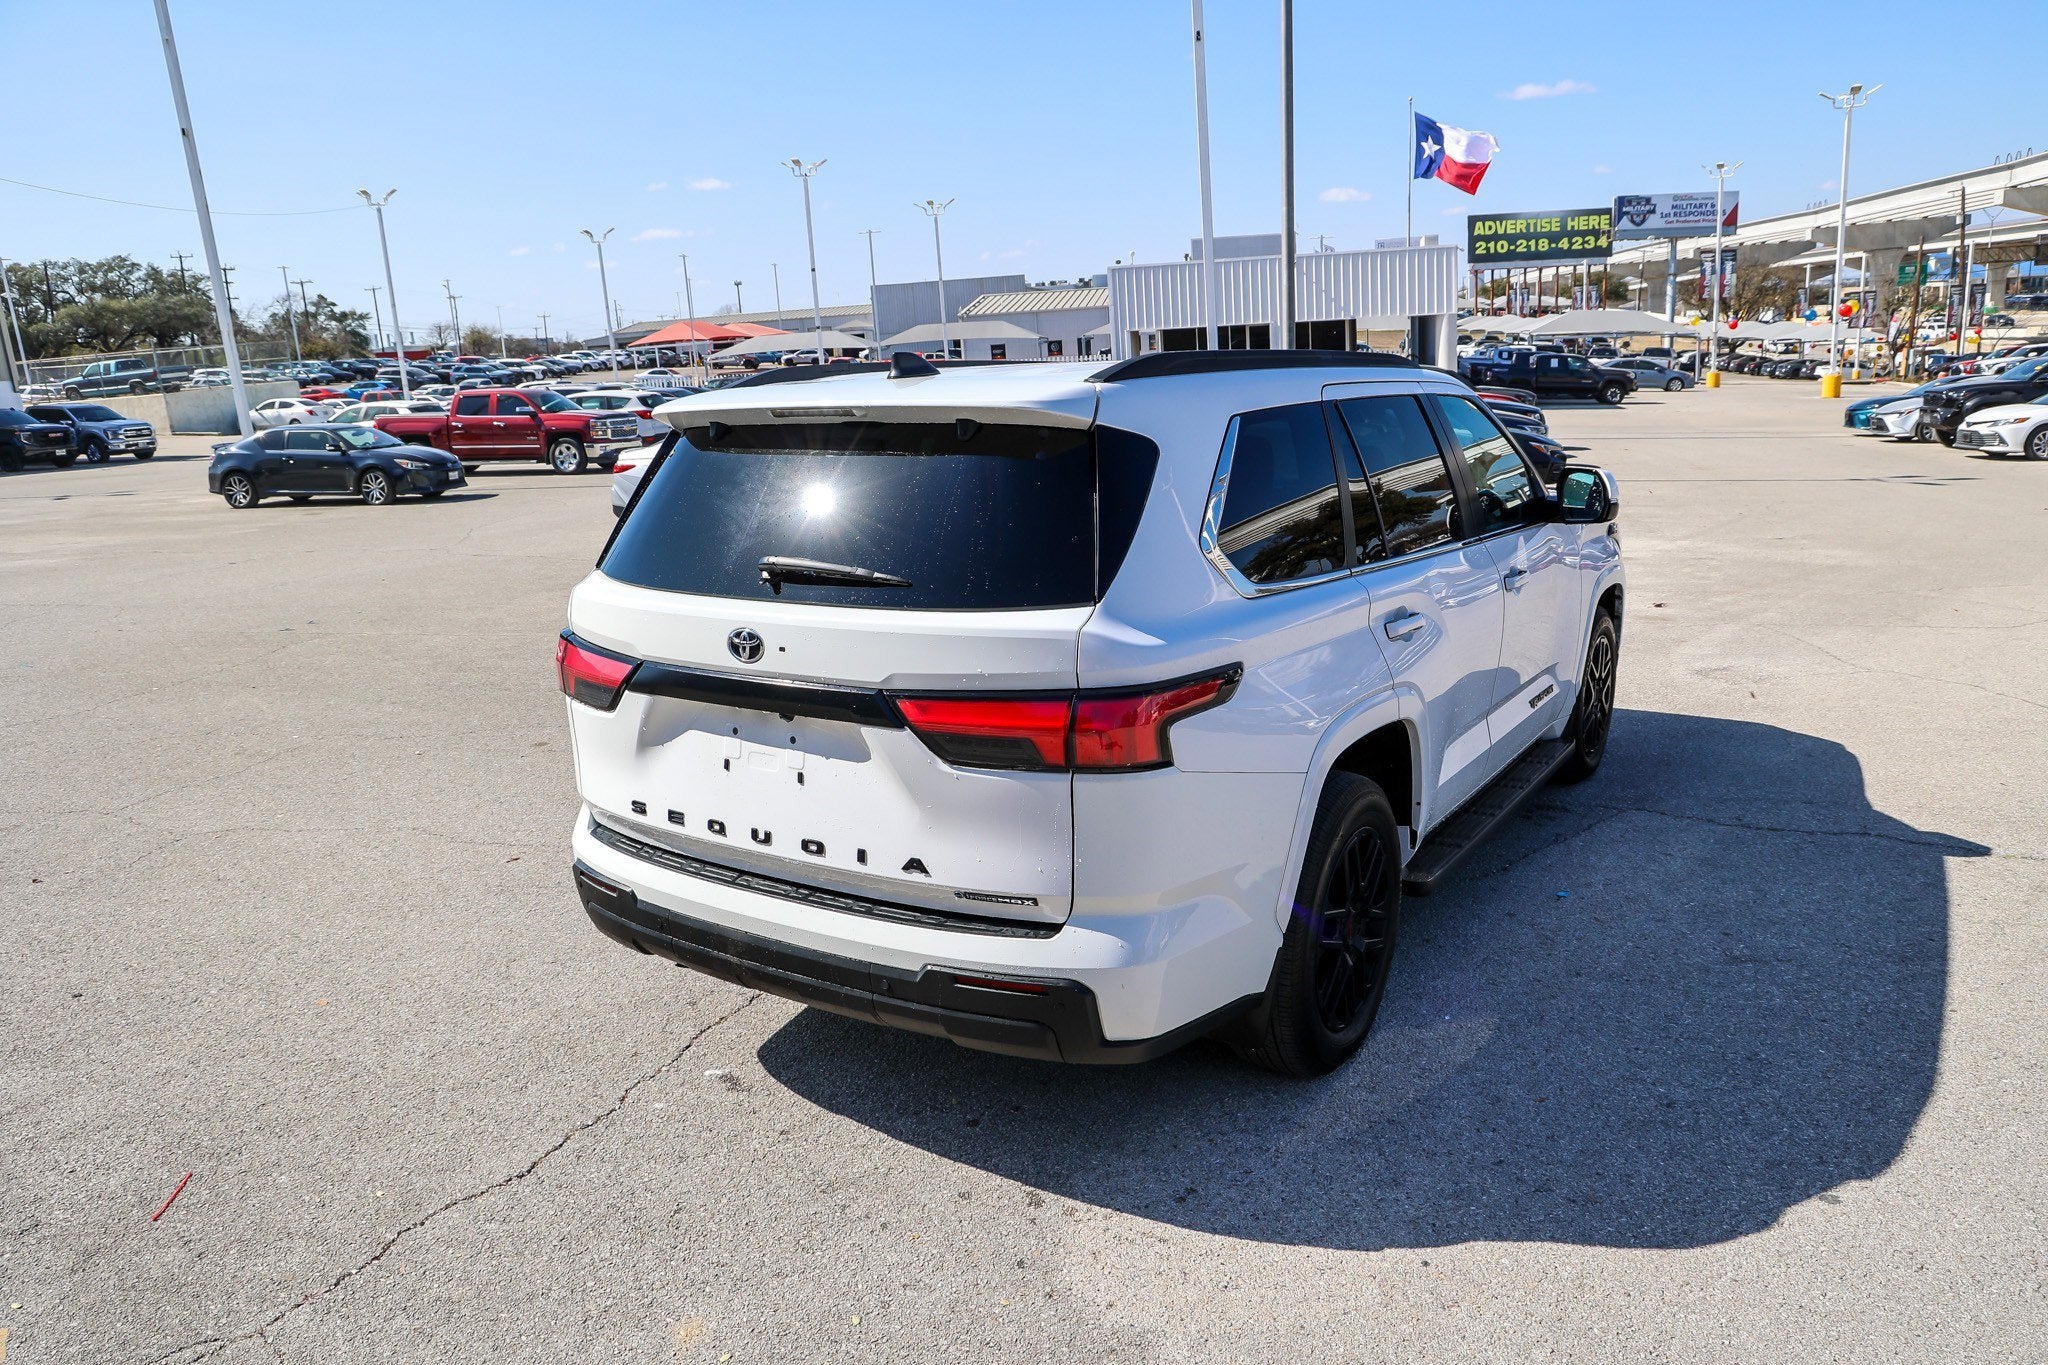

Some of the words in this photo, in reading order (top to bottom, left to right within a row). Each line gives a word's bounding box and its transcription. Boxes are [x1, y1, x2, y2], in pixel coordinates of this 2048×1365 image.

[1660, 211, 1671, 219] 1st
[1673, 209, 1727, 218] RESPONDES
[1710, 201, 1717, 209] &
[1473, 217, 1561, 236] ADVERTISE
[1567, 214, 1611, 231] HERE
[1475, 235, 1609, 255] 210-218-4234
[630, 799, 932, 878] SEQUOIA
